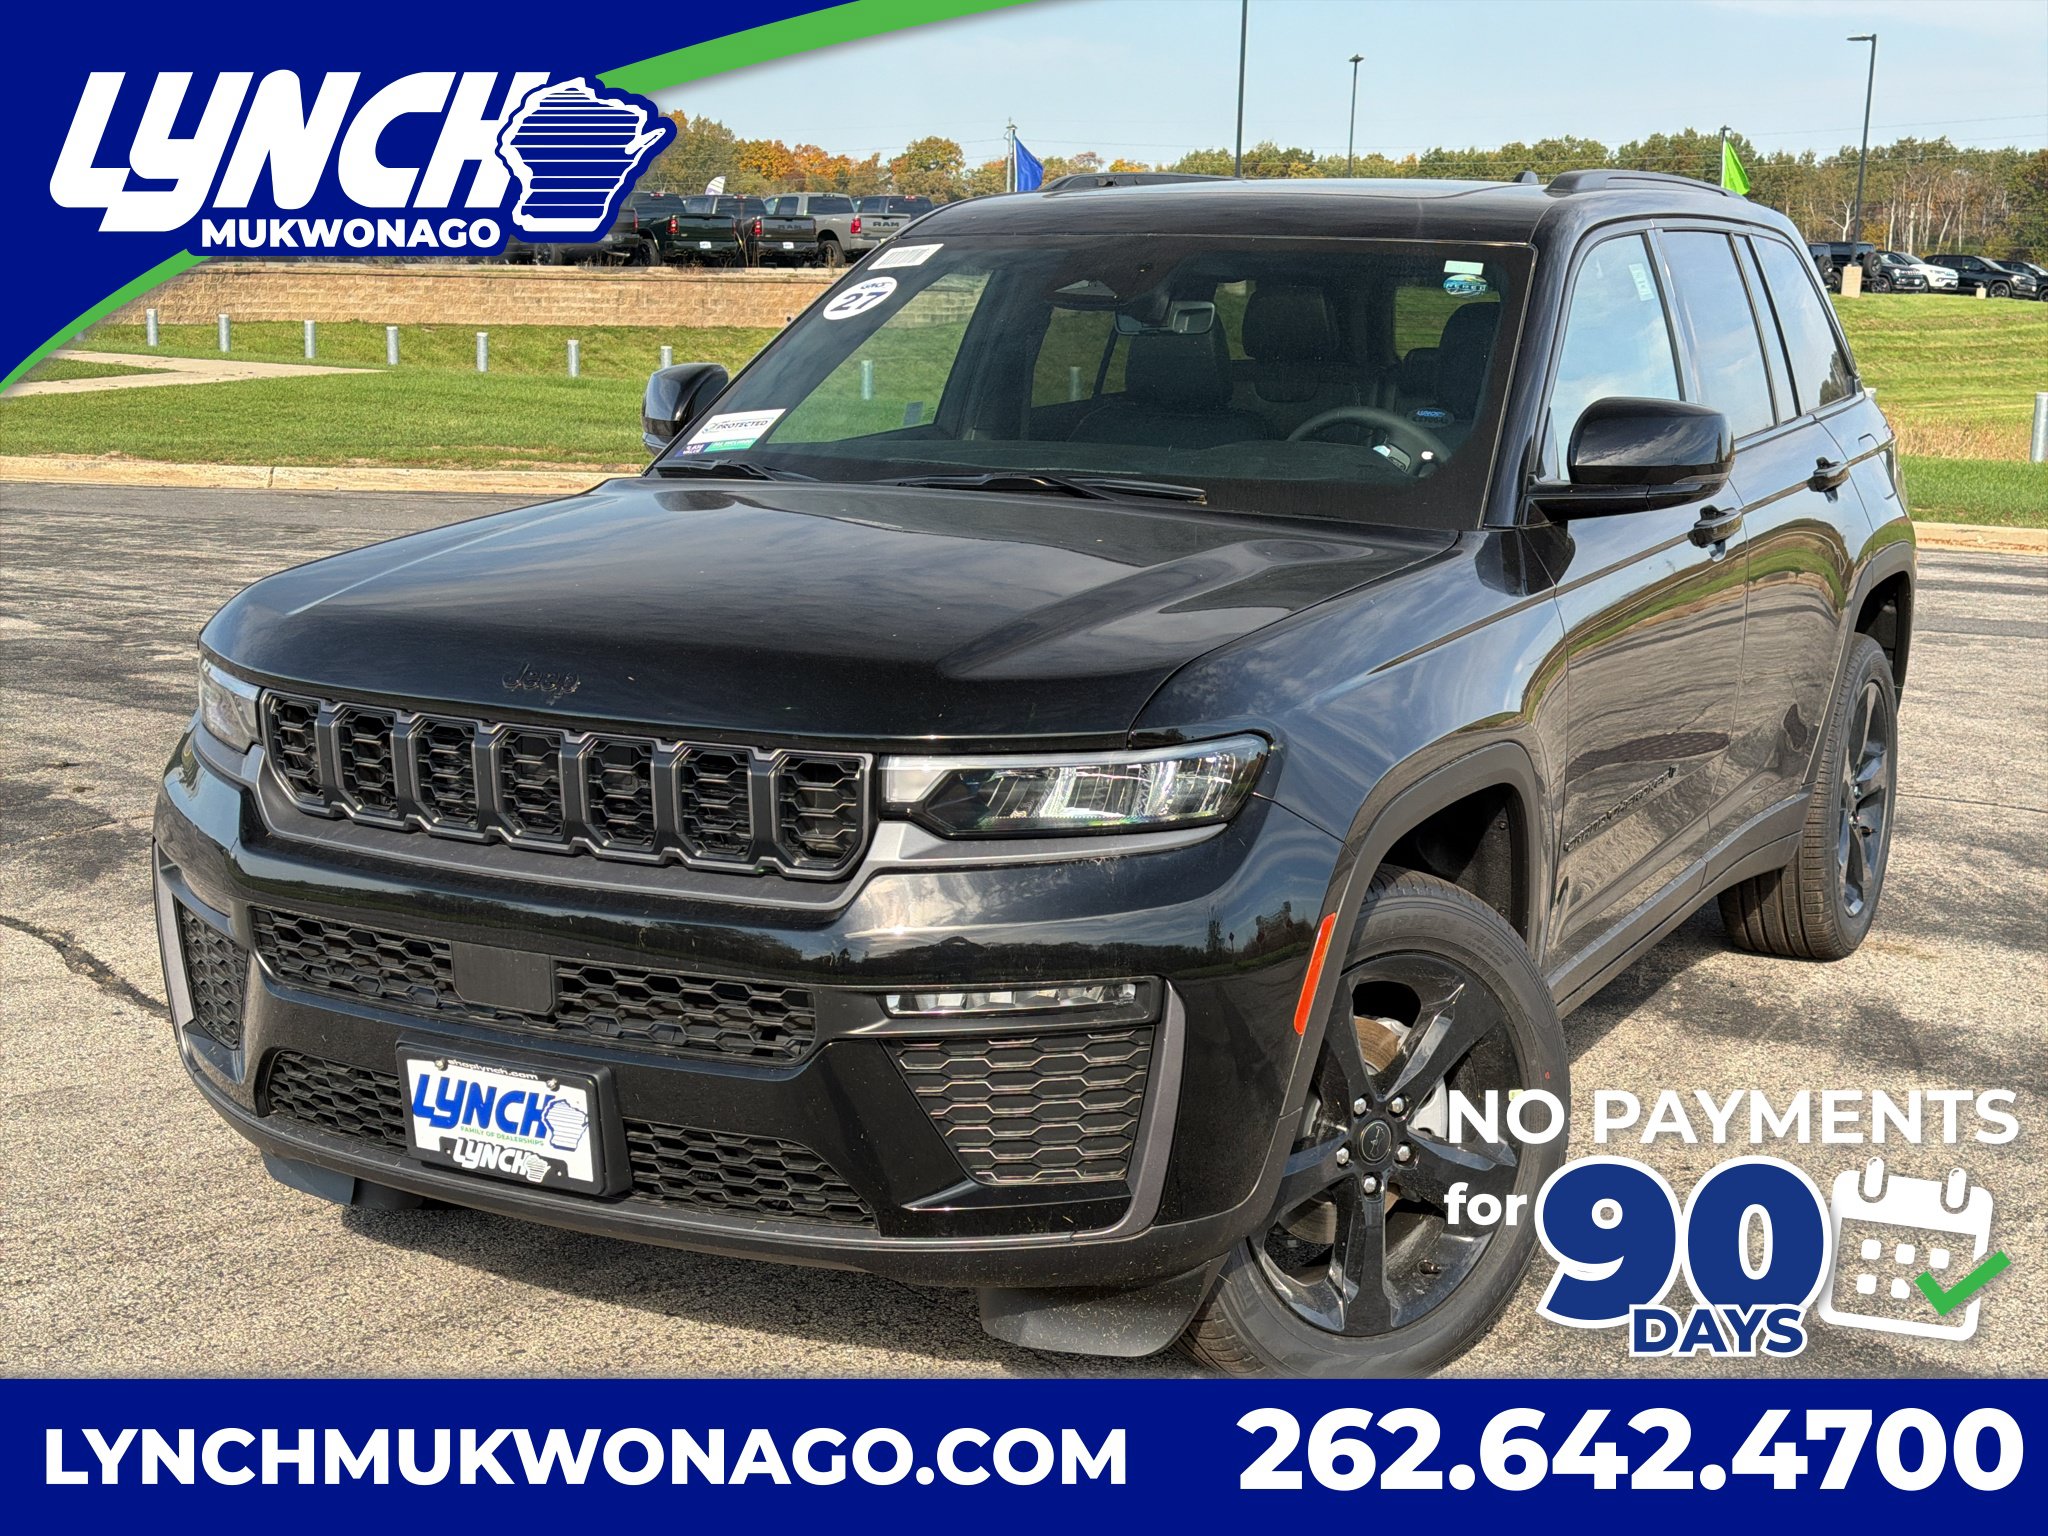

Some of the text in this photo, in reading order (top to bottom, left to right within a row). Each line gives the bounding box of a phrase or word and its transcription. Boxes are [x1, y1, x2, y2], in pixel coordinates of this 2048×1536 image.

[829, 291, 889, 312] 27
[716, 420, 769, 430] PROTECTED
[501, 663, 581, 706] Jeep
[447, 1059, 539, 1081] shoplynch.com
[412, 1073, 556, 1139] LYNCH
[460, 1125, 545, 1147] FAMILY OF DEALERSHIPS
[452, 1137, 531, 1176] LYNCH
